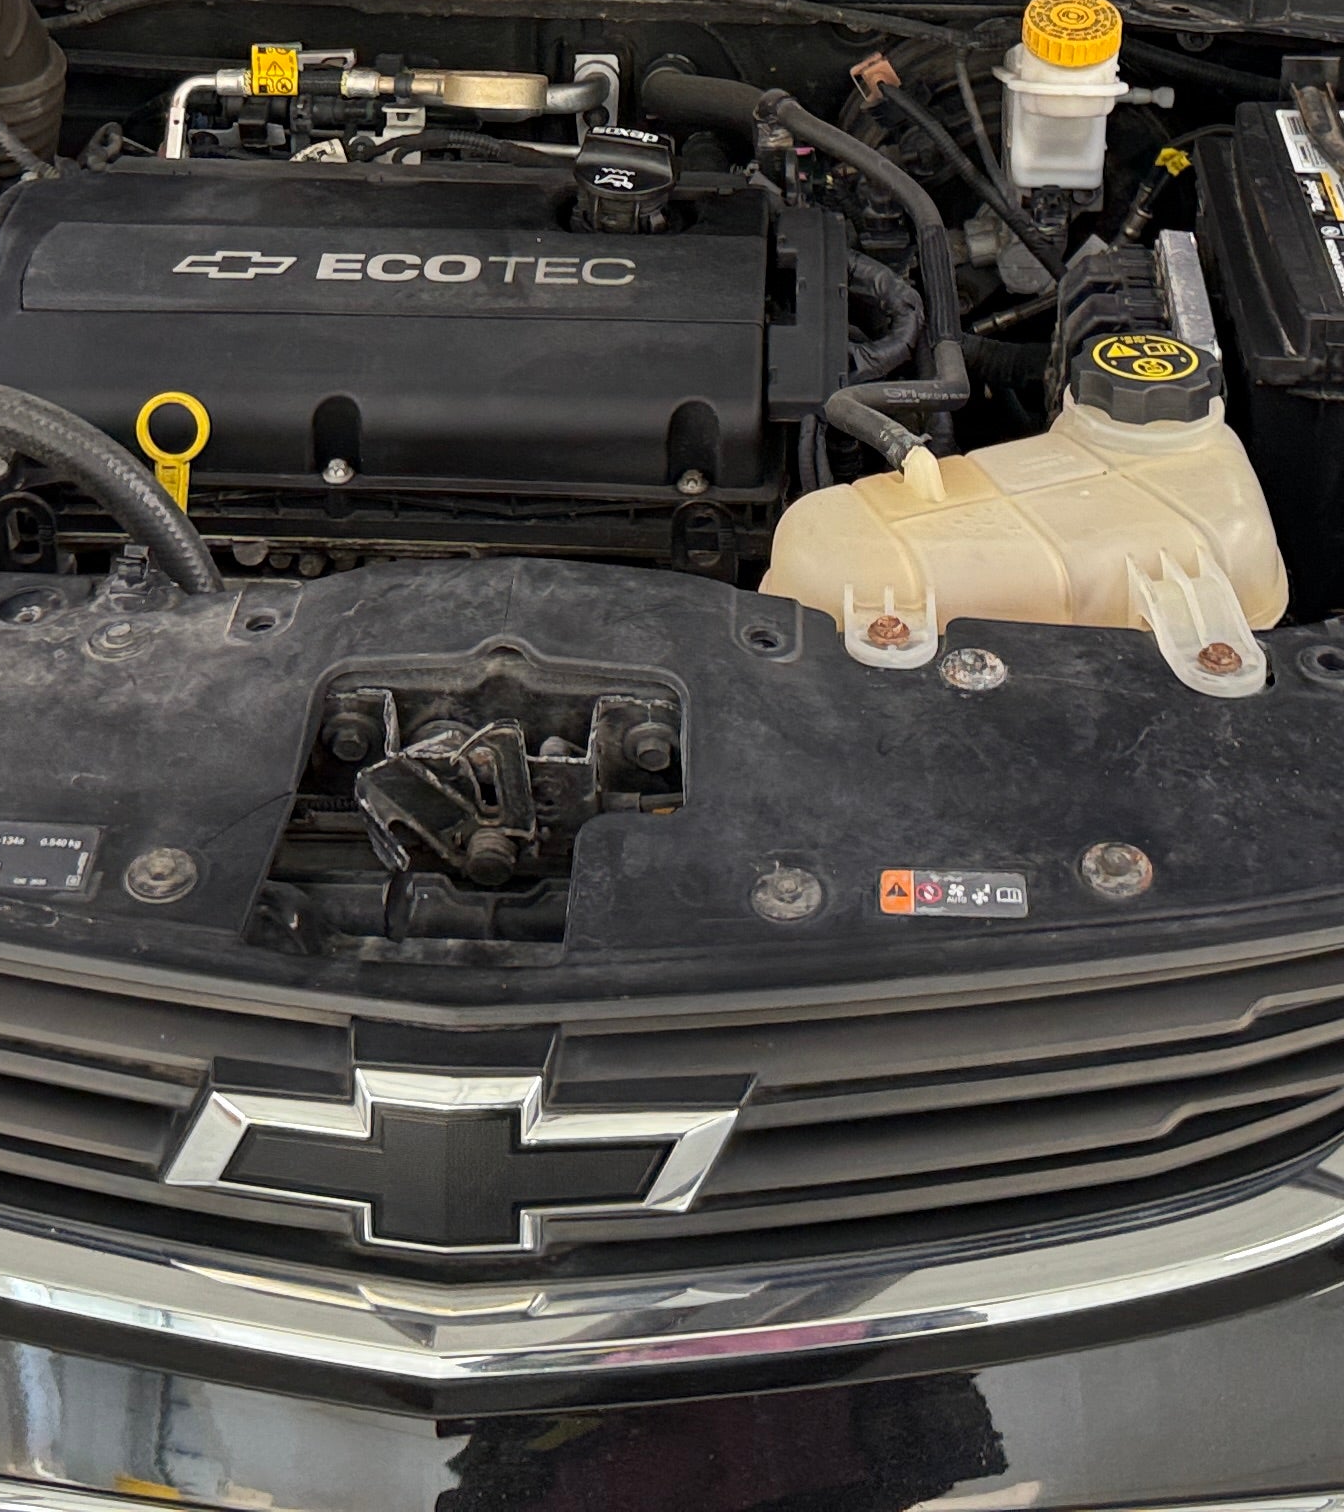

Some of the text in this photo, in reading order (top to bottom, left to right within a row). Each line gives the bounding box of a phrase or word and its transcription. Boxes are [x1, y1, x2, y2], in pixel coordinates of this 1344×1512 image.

[592, 126, 659, 143] dexos
[316, 253, 636, 285] ECOTEC
[946, 895, 968, 904] AUTO
